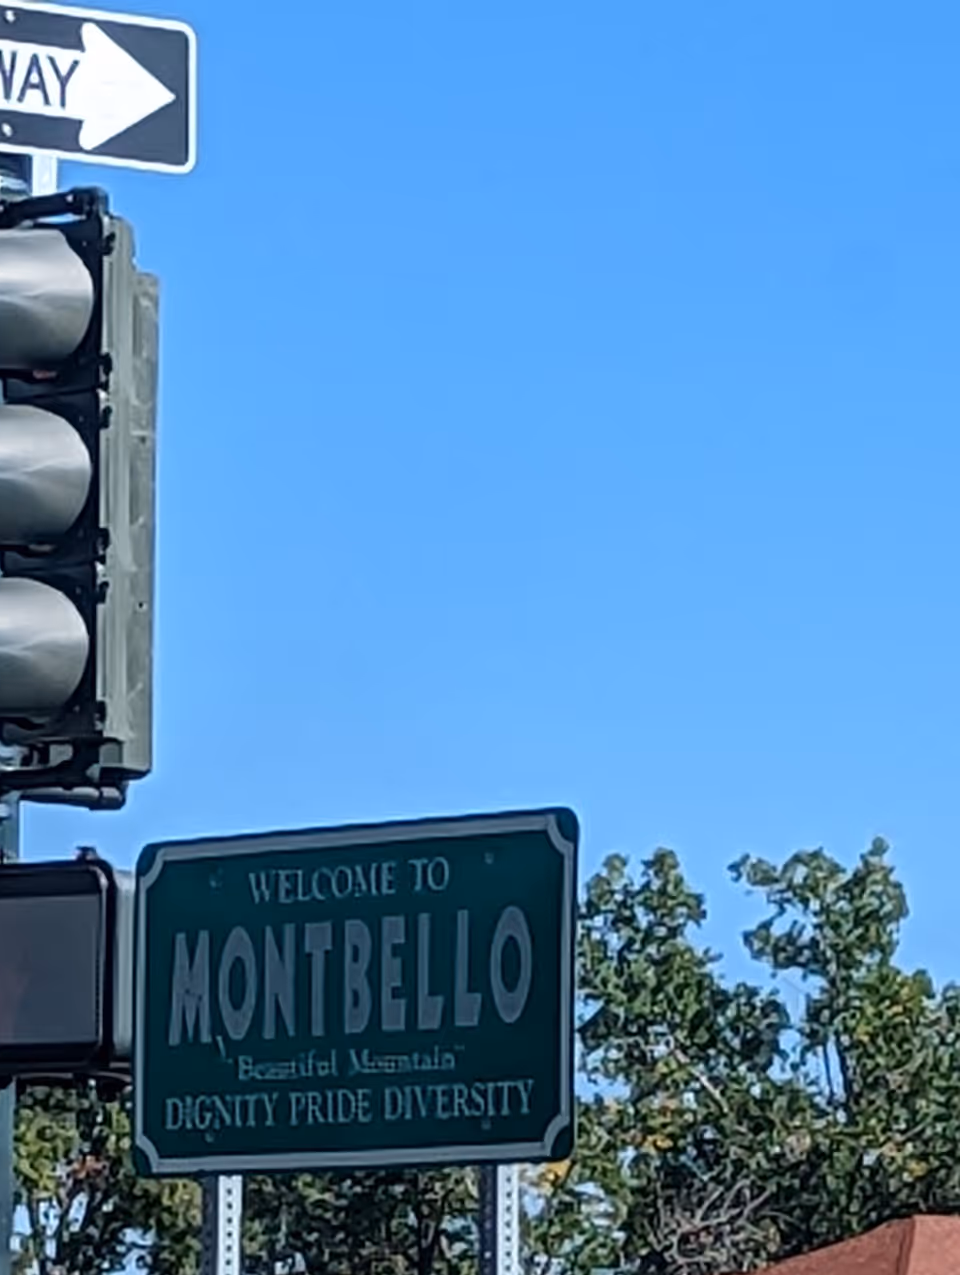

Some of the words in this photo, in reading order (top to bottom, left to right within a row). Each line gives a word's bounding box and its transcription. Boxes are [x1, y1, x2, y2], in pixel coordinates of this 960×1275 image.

[248, 862, 397, 904] WELCOME
[409, 857, 450, 892] TO
[168, 905, 533, 1046] MONTBELLO
[165, 1091, 279, 1131] DIGNITY
[290, 1088, 372, 1126] PRIDE
[384, 1079, 534, 1121] DIVERSITY
